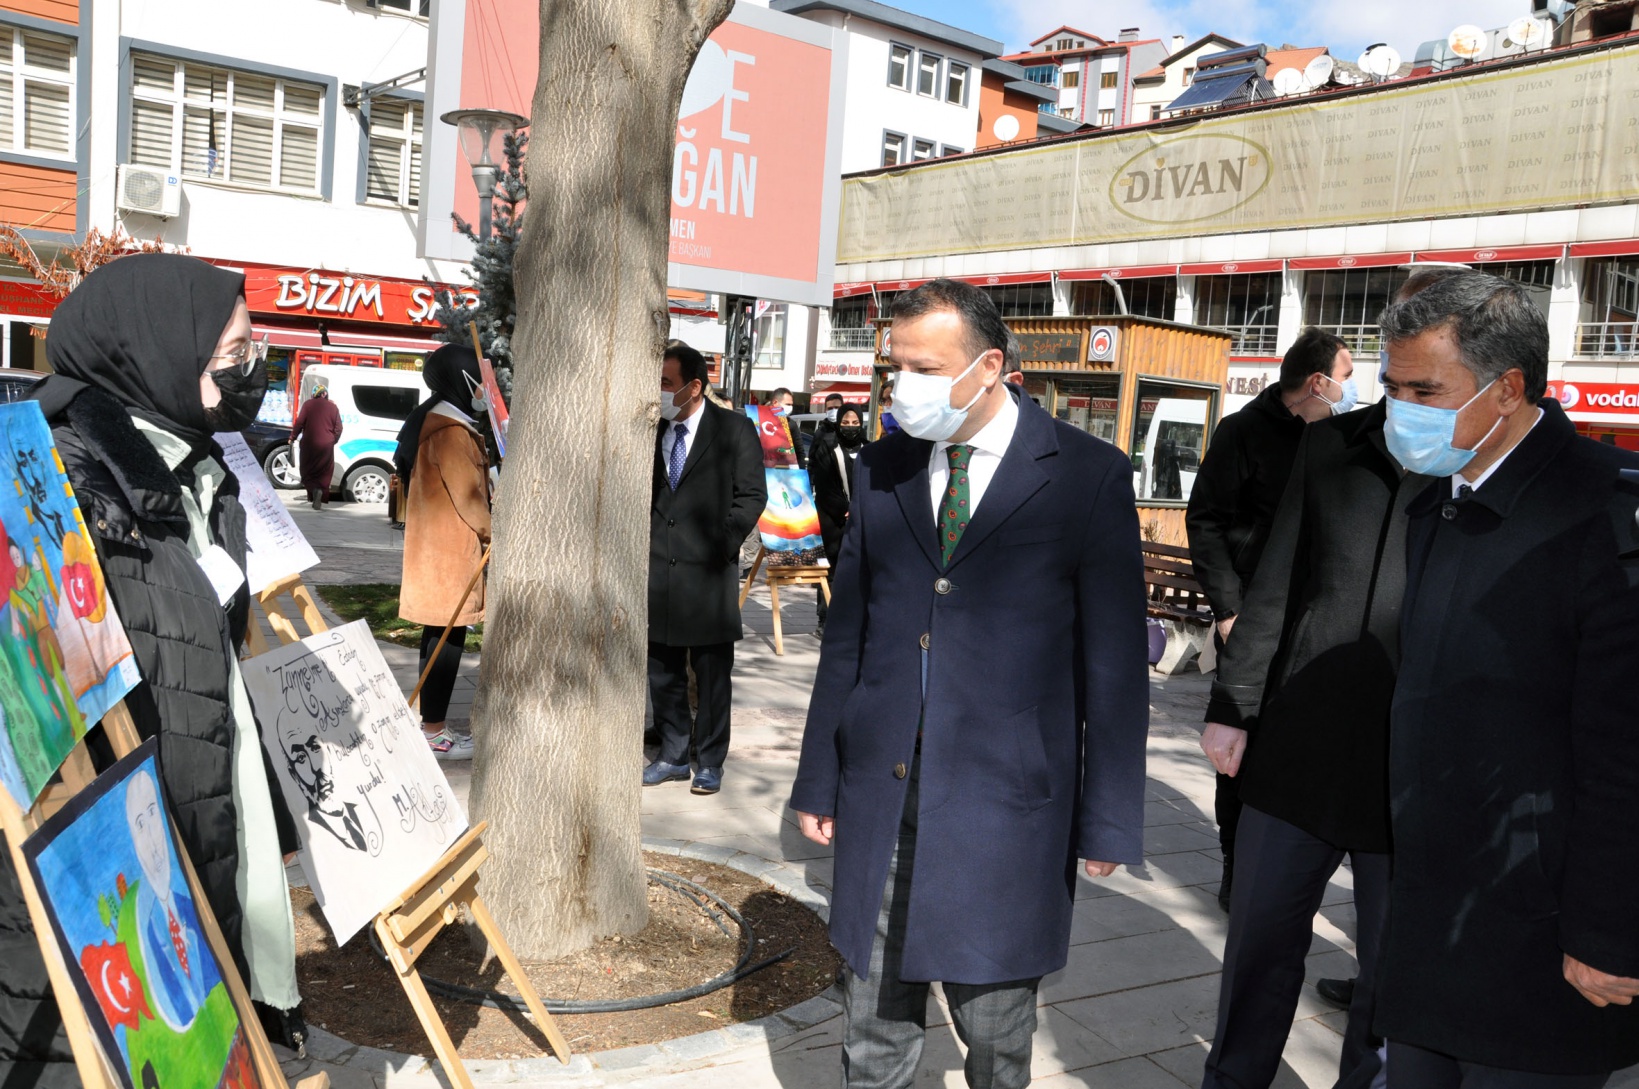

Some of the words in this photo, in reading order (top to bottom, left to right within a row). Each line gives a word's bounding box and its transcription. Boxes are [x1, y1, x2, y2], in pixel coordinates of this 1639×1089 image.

[672, 125, 758, 219] ĞAN
[1123, 156, 1248, 204] DİVAN
[678, 242, 712, 258] BAŞKANI
[1032, 338, 1062, 358] Şehri
